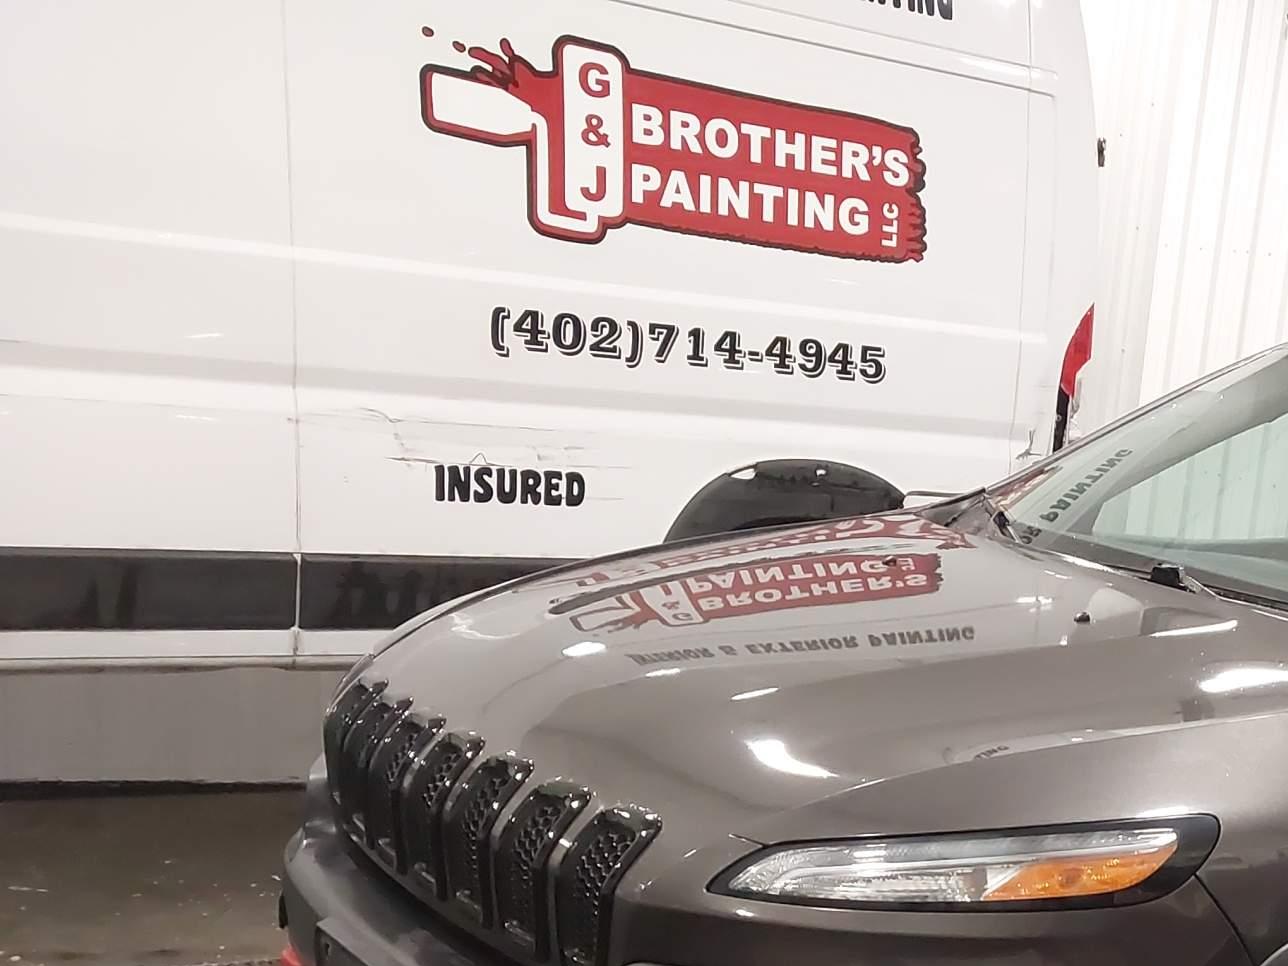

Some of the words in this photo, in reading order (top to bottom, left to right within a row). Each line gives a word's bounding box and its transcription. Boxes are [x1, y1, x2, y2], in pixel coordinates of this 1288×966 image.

[579, 62, 610, 97] G
[581, 114, 611, 148] &
[631, 103, 910, 188] BROTHER'S
[580, 165, 607, 202] J
[631, 164, 870, 235] PAINTING
[881, 202, 899, 248] LLC
[490, 306, 886, 384] (402)714-4945
[435, 464, 585, 507] INSURED
